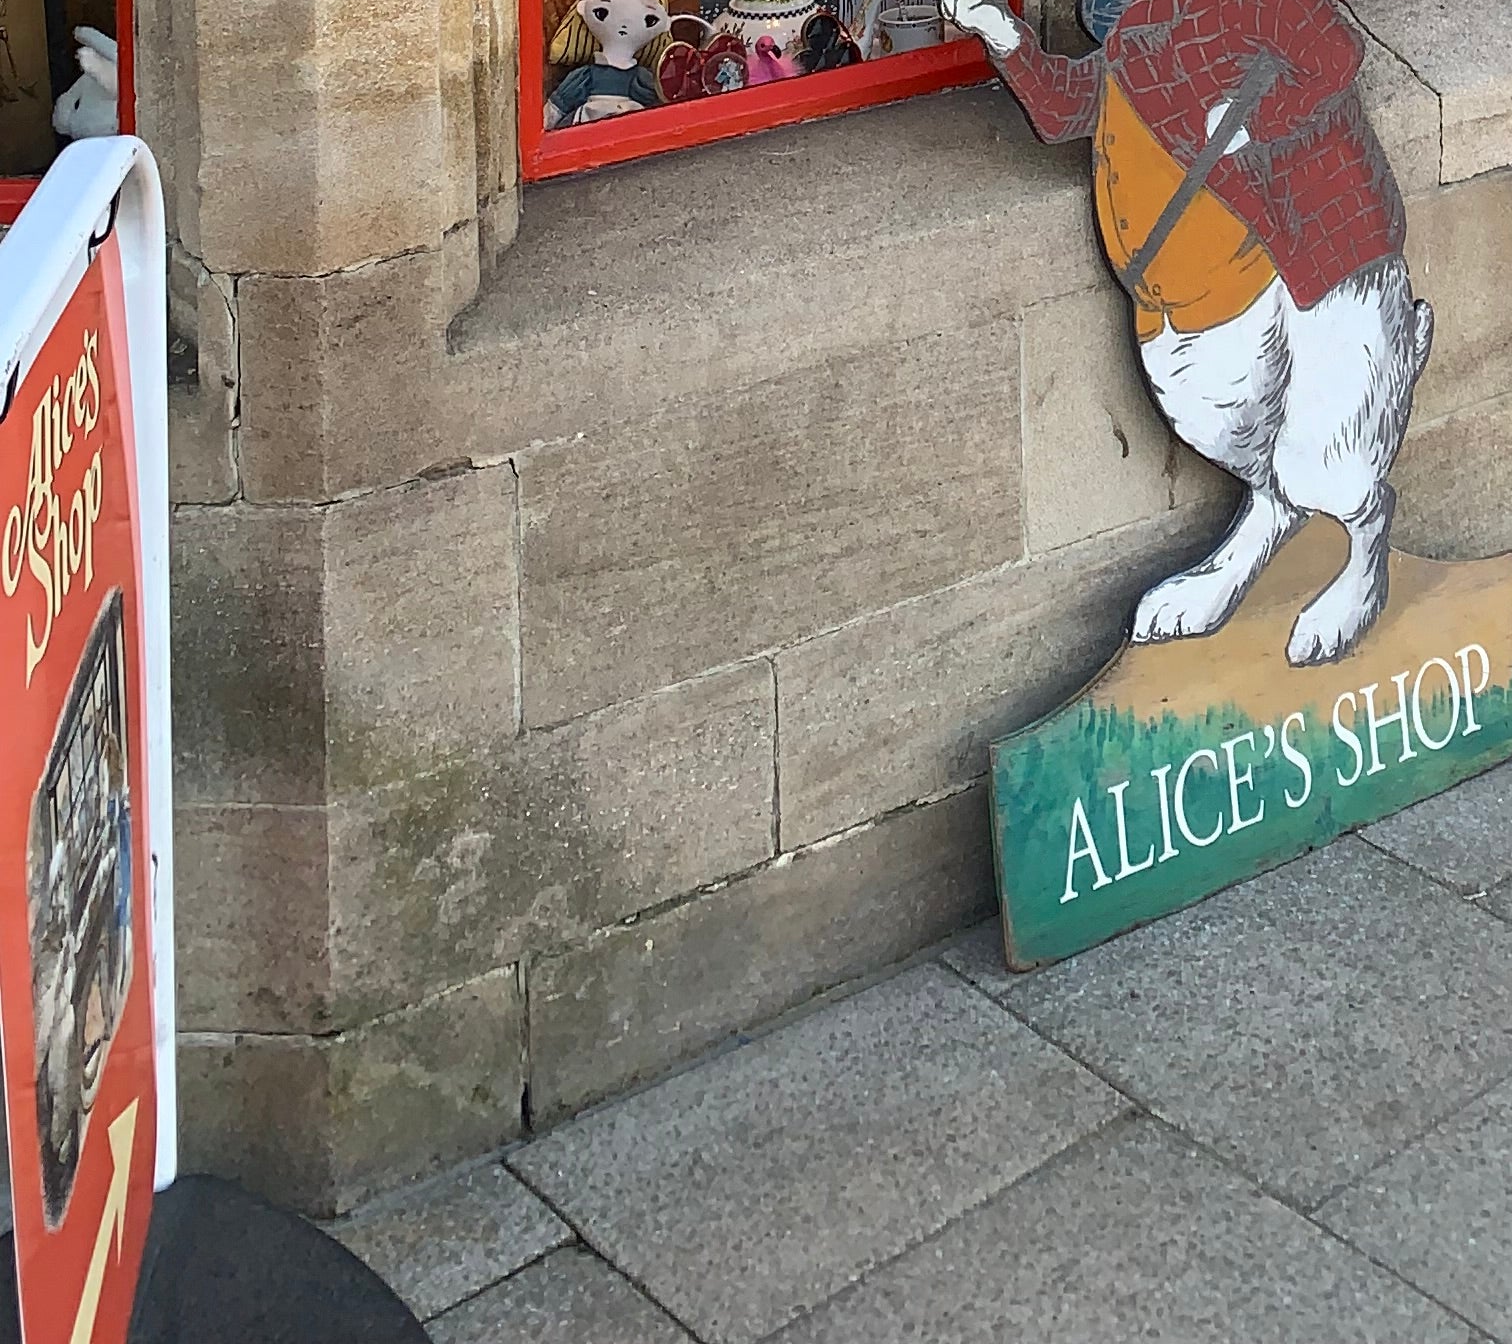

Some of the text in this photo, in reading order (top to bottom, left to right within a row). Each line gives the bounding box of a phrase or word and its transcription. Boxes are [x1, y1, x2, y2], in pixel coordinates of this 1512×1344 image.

[1, 327, 99, 600] Alice's
[25, 446, 104, 690] Shop
[1058, 643, 1491, 905] ALICE'S SHOP
